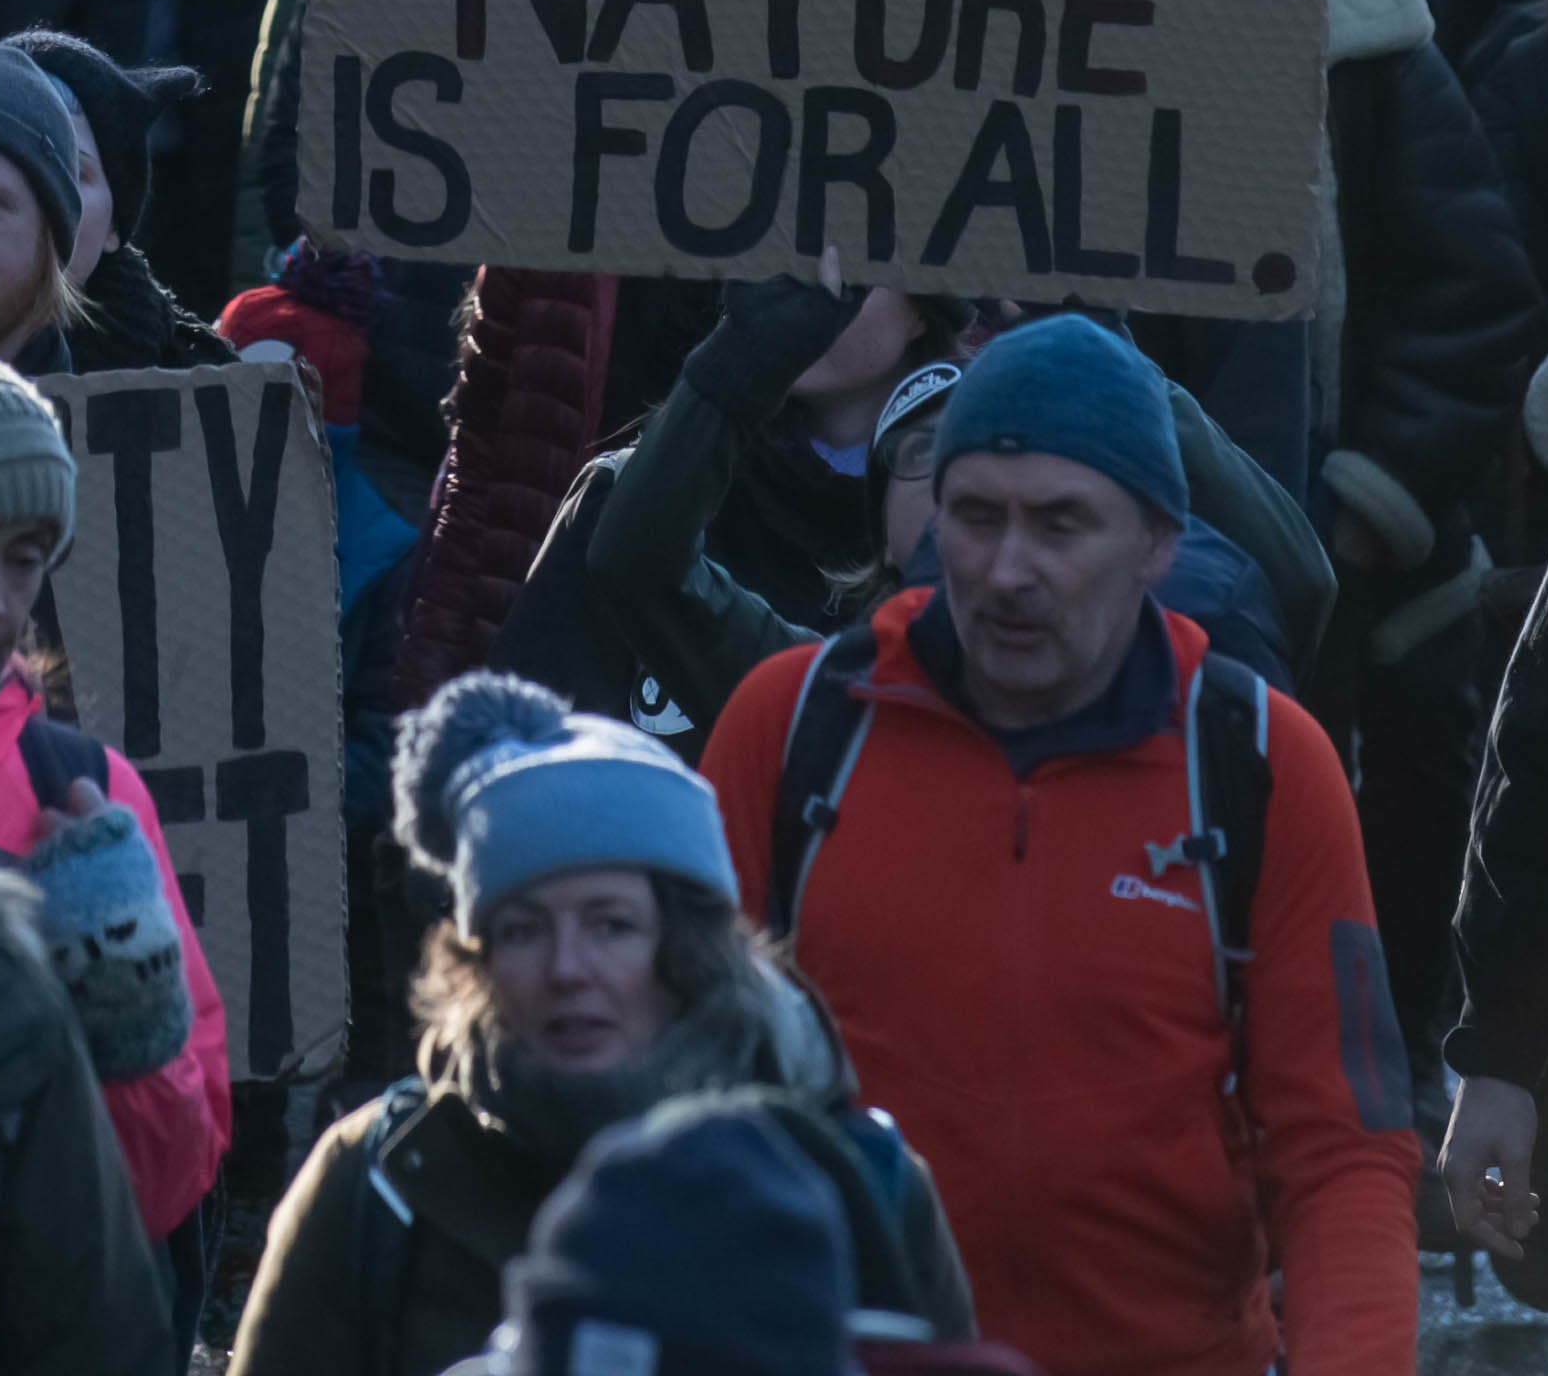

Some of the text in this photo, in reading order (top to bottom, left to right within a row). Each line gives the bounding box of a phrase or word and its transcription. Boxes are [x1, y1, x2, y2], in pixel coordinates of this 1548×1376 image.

[332, 51, 1297, 296] IS FOR ALL.
